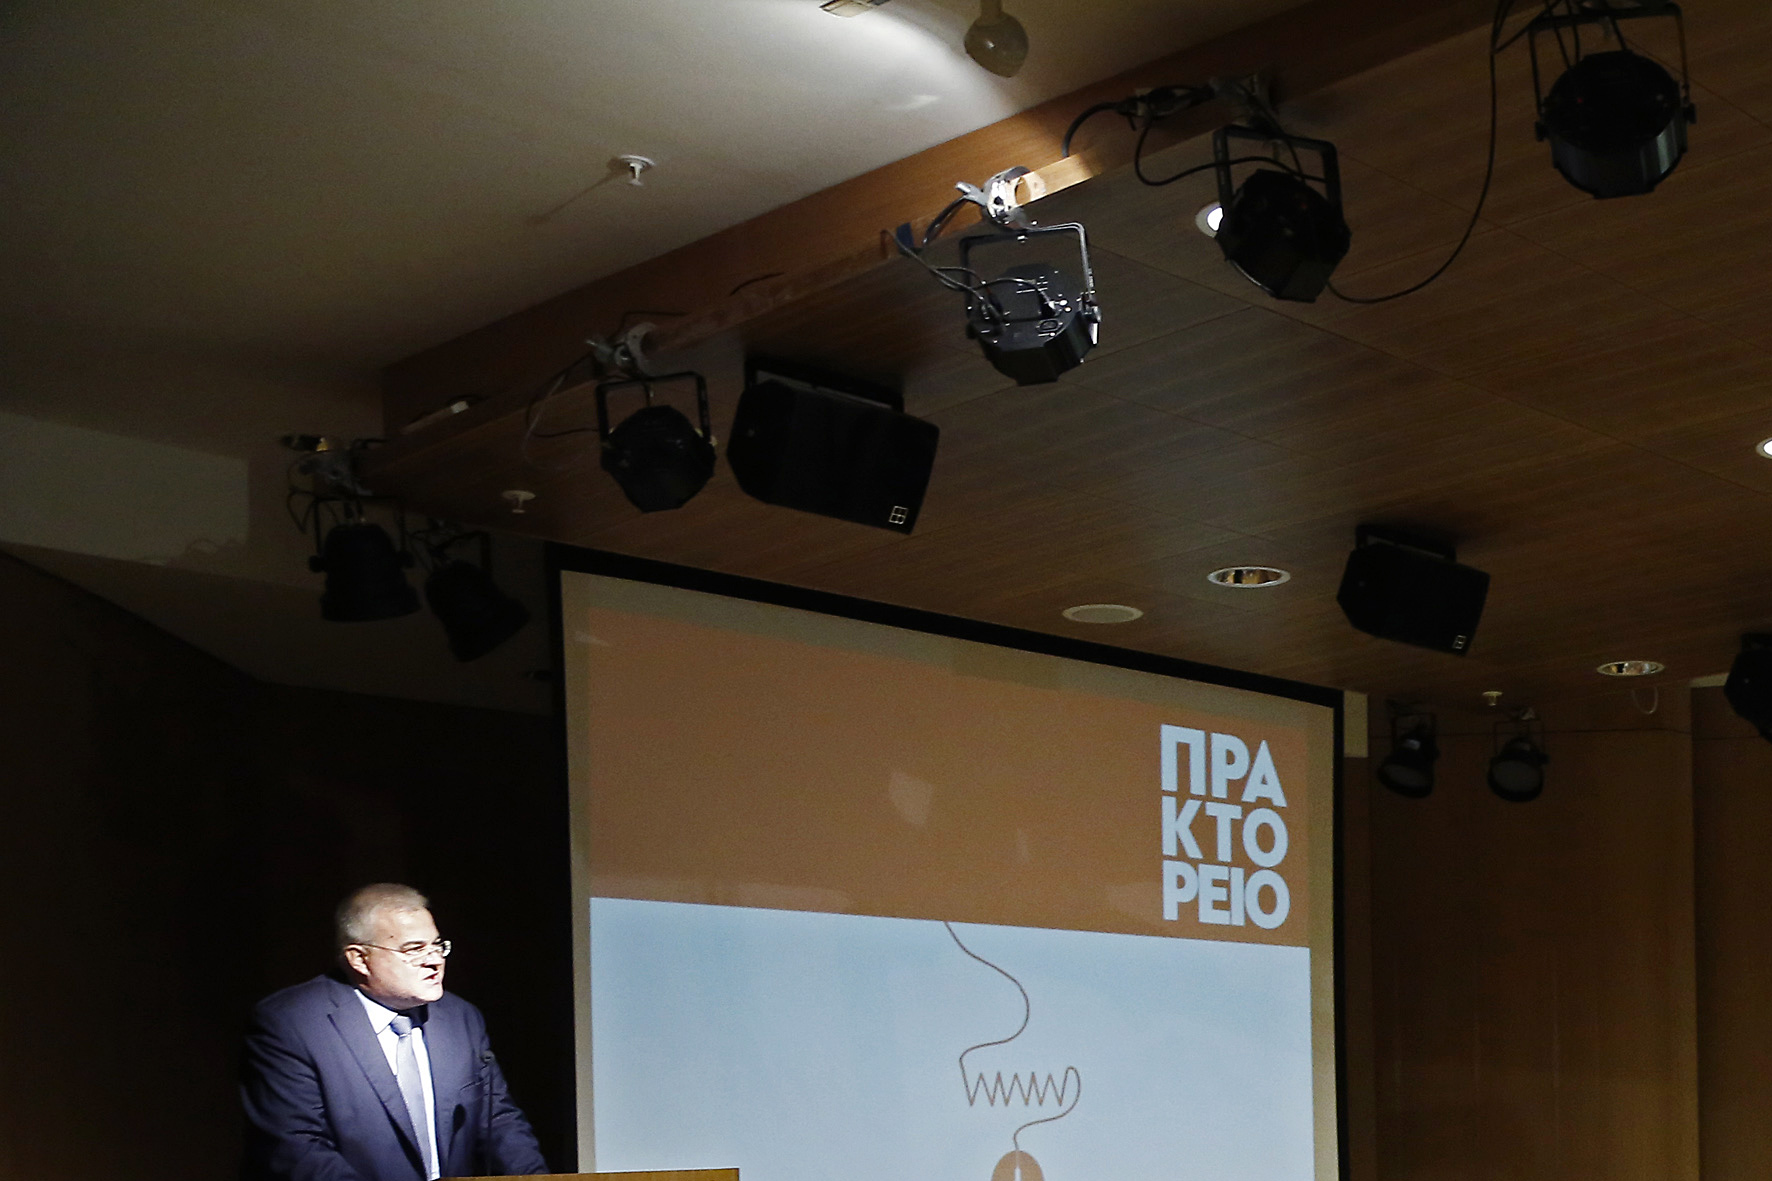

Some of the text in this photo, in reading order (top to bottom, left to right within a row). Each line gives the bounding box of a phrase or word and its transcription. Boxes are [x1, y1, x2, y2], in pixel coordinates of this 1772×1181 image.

[1161, 724, 1287, 807] ΠΡΑ
[1162, 796, 1289, 868] ΚΤΟ
[1163, 859, 1291, 930] ΡΕΙΟ
